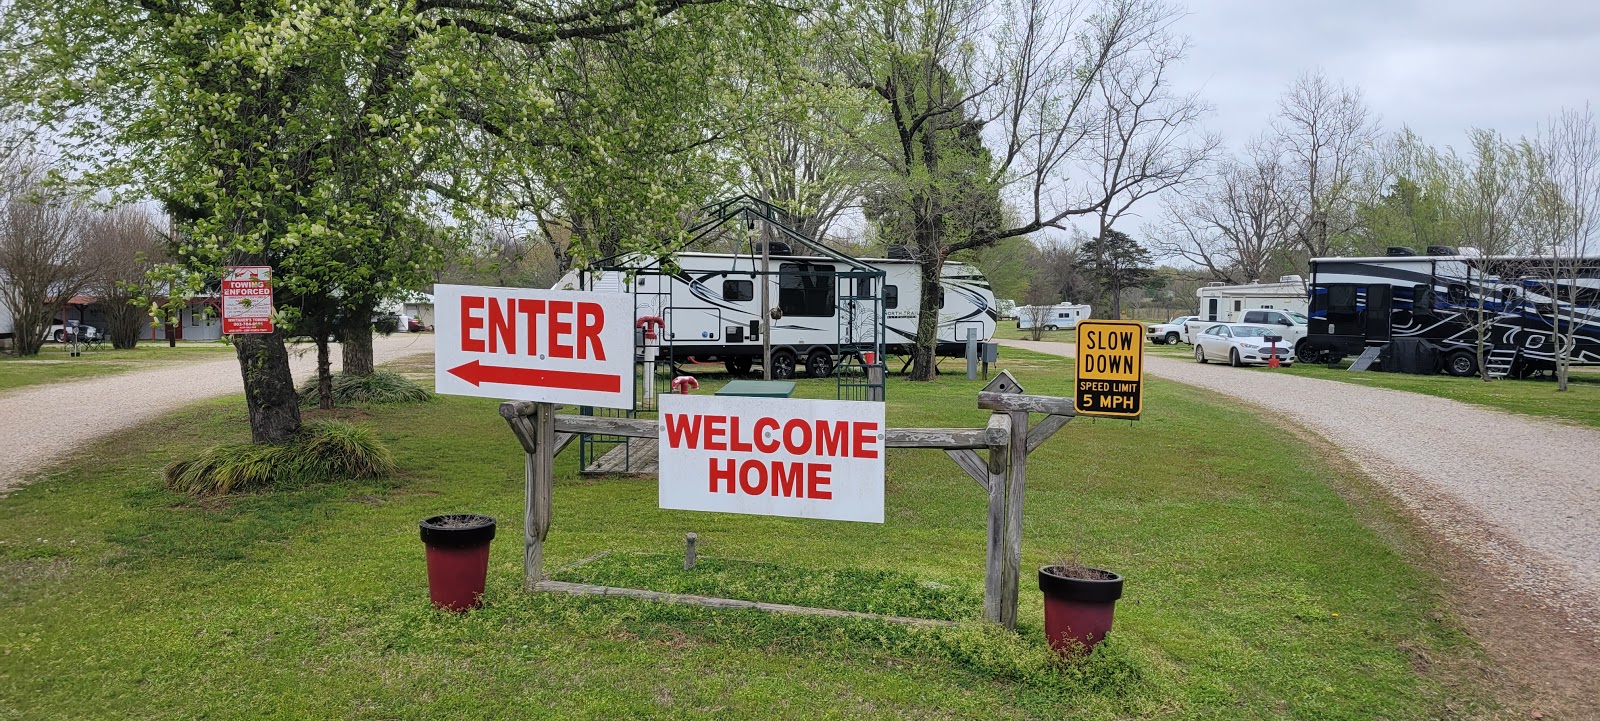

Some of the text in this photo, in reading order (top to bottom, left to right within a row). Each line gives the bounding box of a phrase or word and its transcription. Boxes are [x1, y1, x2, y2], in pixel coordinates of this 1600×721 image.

[461, 296, 606, 361] ENTER
[1086, 330, 1133, 350] SLOW
[1085, 354, 1133, 374] DOWN
[1080, 381, 1137, 392] SPEED LIMIT
[1083, 394, 1133, 409] 5 MPH
[664, 413, 878, 459] WELCOME
[709, 457, 832, 500] HOME
